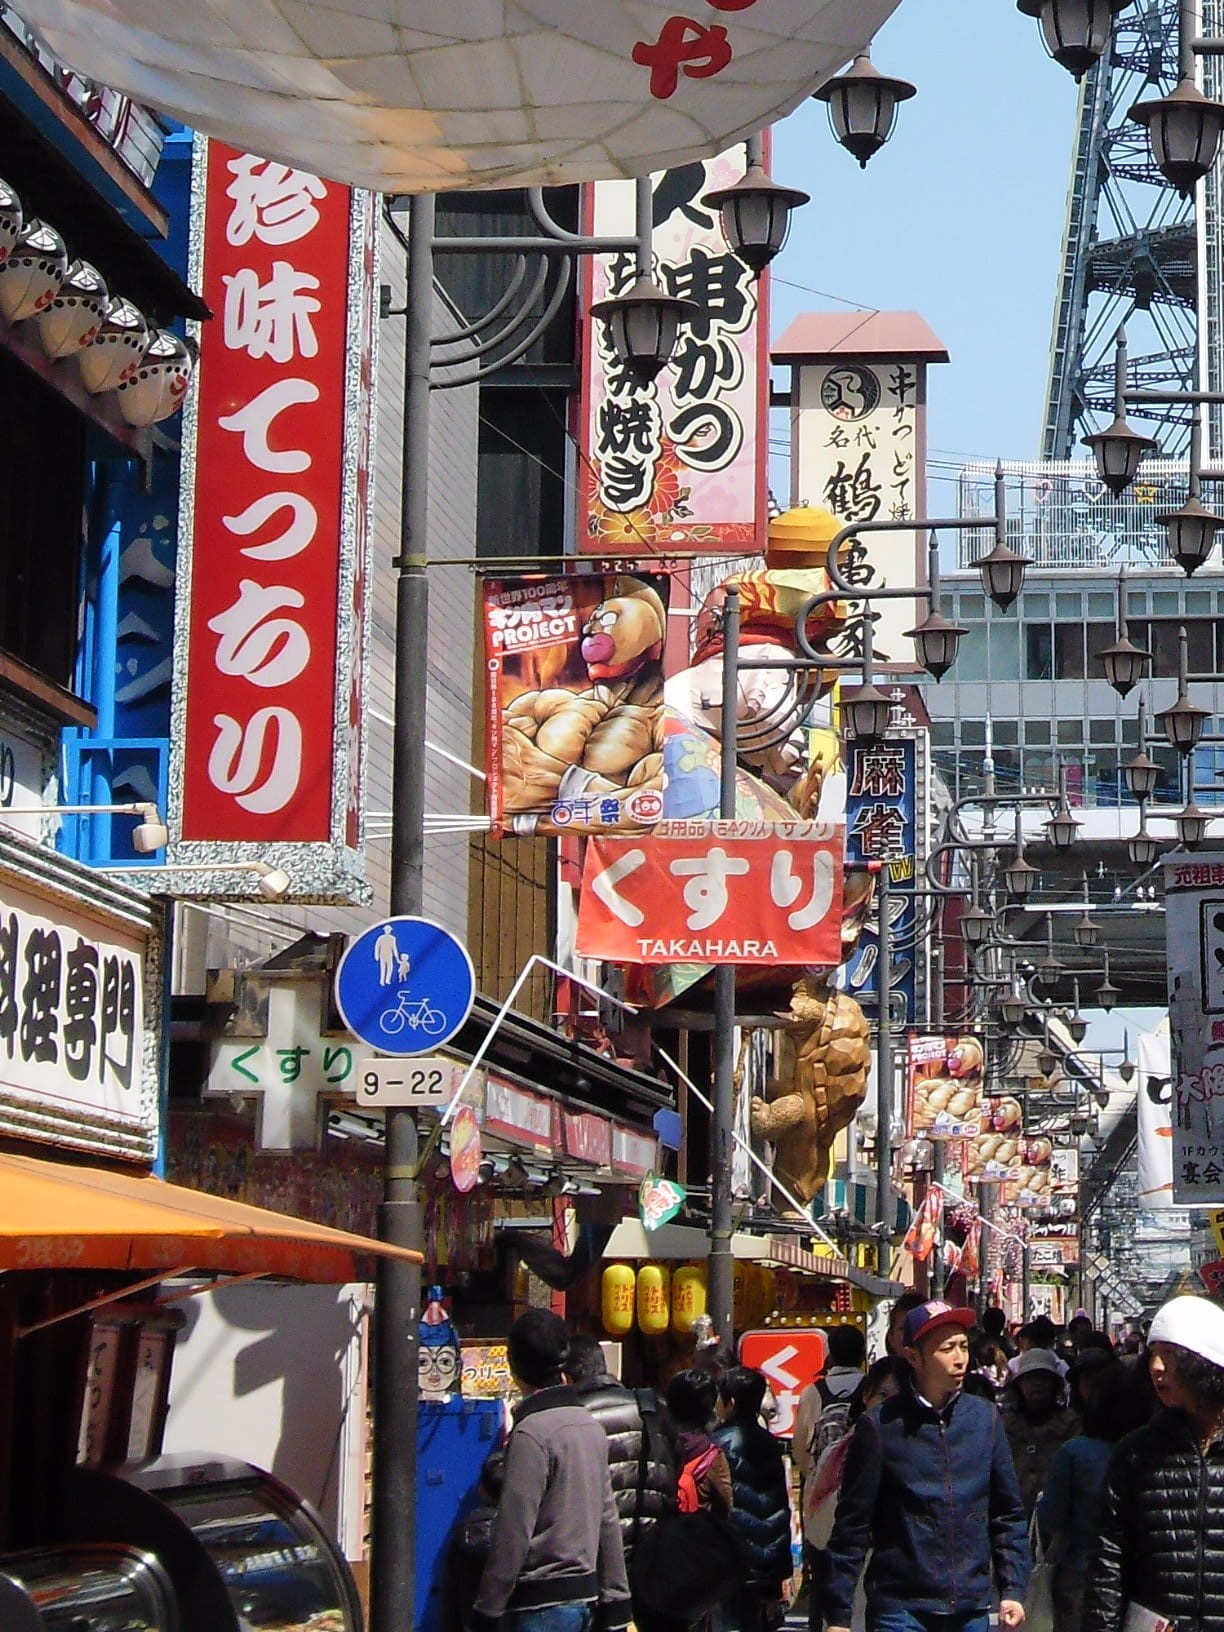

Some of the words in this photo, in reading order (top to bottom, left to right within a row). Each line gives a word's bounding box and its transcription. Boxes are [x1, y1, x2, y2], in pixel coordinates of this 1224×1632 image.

[824, 425, 880, 449] 名代
[492, 615, 577, 648] PROJECT
[850, 744, 907, 856] 麻雀
[592, 847, 834, 932] くすり
[636, 939, 779, 958] TAKAHARA
[231, 1045, 353, 1084] くすり
[363, 1070, 443, 1096] 9-22
